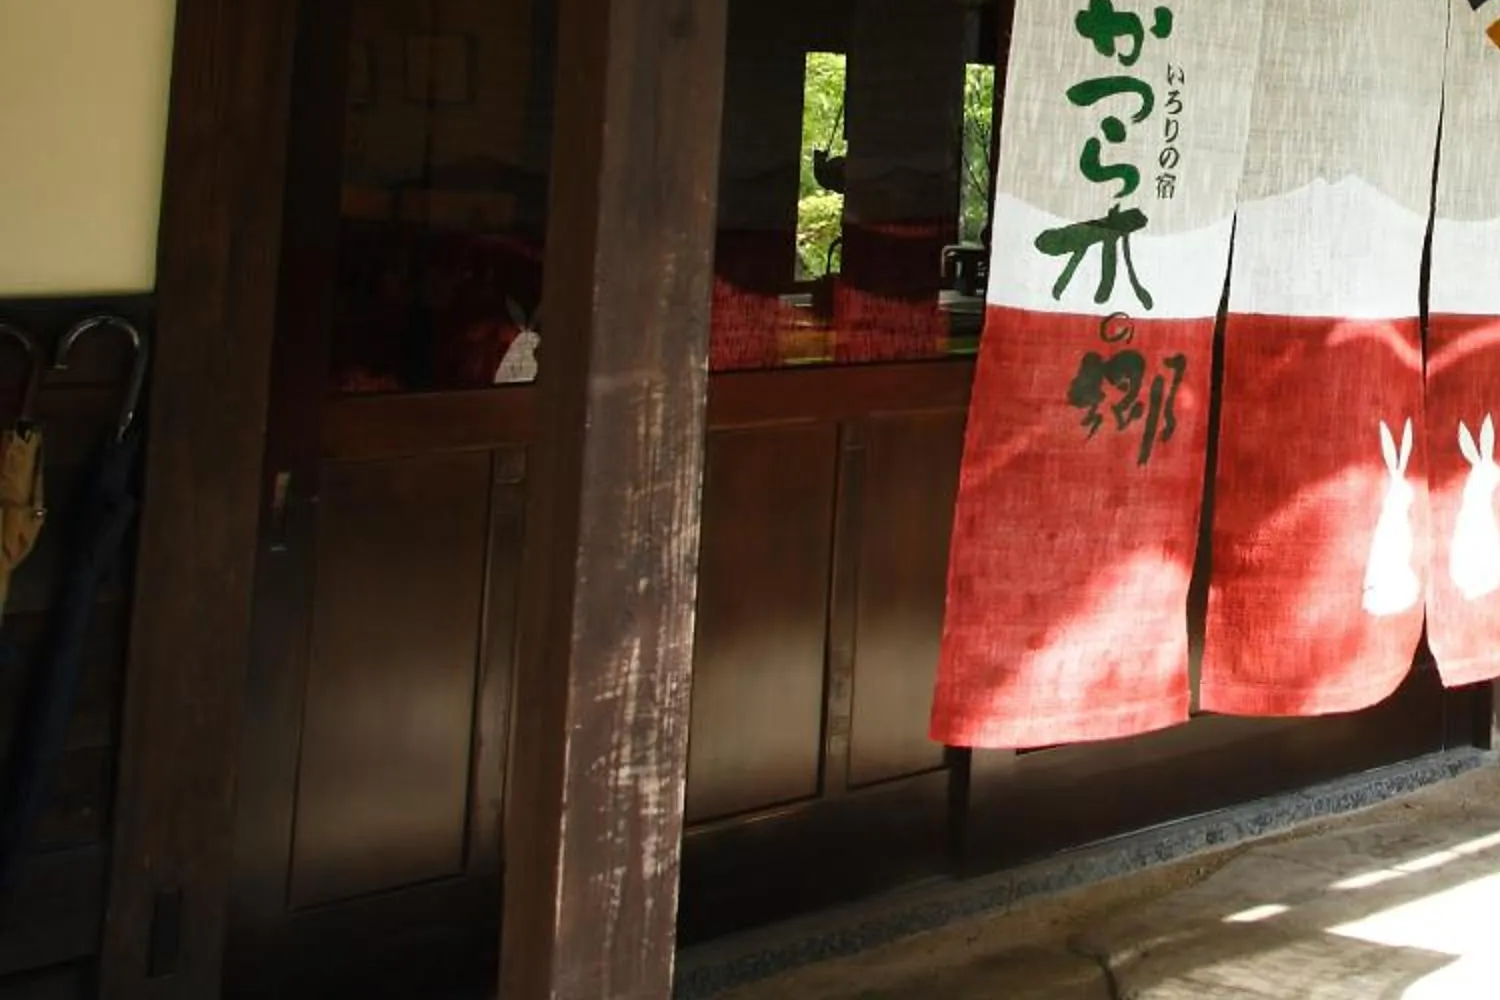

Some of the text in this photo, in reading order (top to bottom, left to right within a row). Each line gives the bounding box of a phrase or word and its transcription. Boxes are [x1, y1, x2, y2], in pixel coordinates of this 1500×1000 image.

[1156, 63, 1186, 199] いろりの宿
